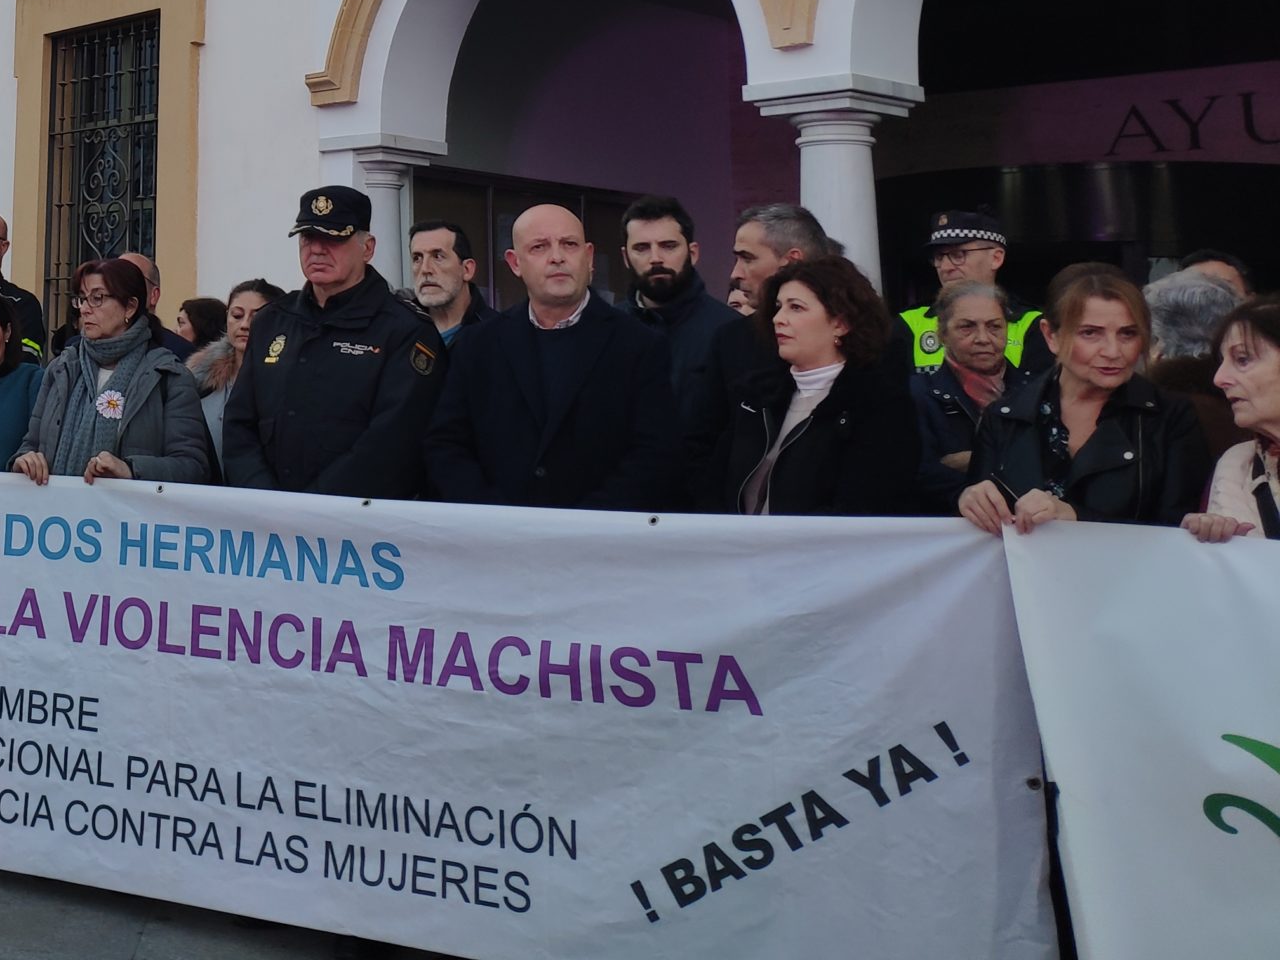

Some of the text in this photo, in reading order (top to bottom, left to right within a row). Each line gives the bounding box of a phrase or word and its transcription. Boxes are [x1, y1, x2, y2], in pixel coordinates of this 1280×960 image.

[4, 513, 405, 591] DOS HERMANAS
[64, 593, 368, 678] VIOLENCIA
[386, 624, 763, 716] MACHISTA
[64, 799, 224, 860] CONTRA
[234, 826, 309, 874] LAS
[323, 840, 531, 914] MUJERES
[125, 755, 226, 806] PARA
[236, 771, 284, 815] LA
[293, 780, 578, 860] ELIMINACIÓN
[660, 789, 850, 908] BASTA
[841, 744, 939, 807] YA
